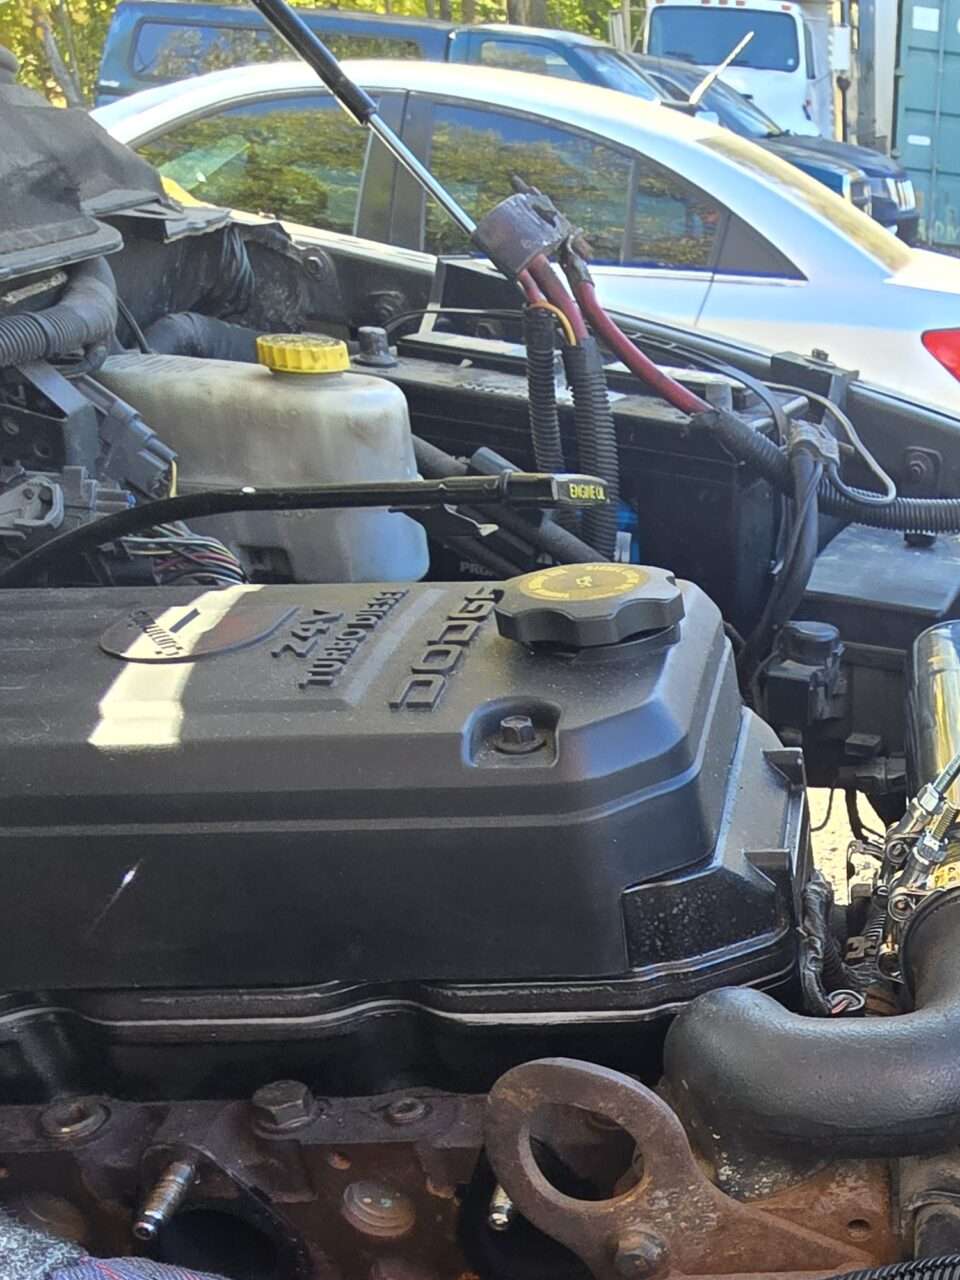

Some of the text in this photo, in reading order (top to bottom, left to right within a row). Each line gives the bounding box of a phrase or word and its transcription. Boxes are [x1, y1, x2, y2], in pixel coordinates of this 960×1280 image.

[271, 609, 343, 658] 24V
[298, 628, 368, 690] TURBO
[388, 587, 504, 711] DODGE
